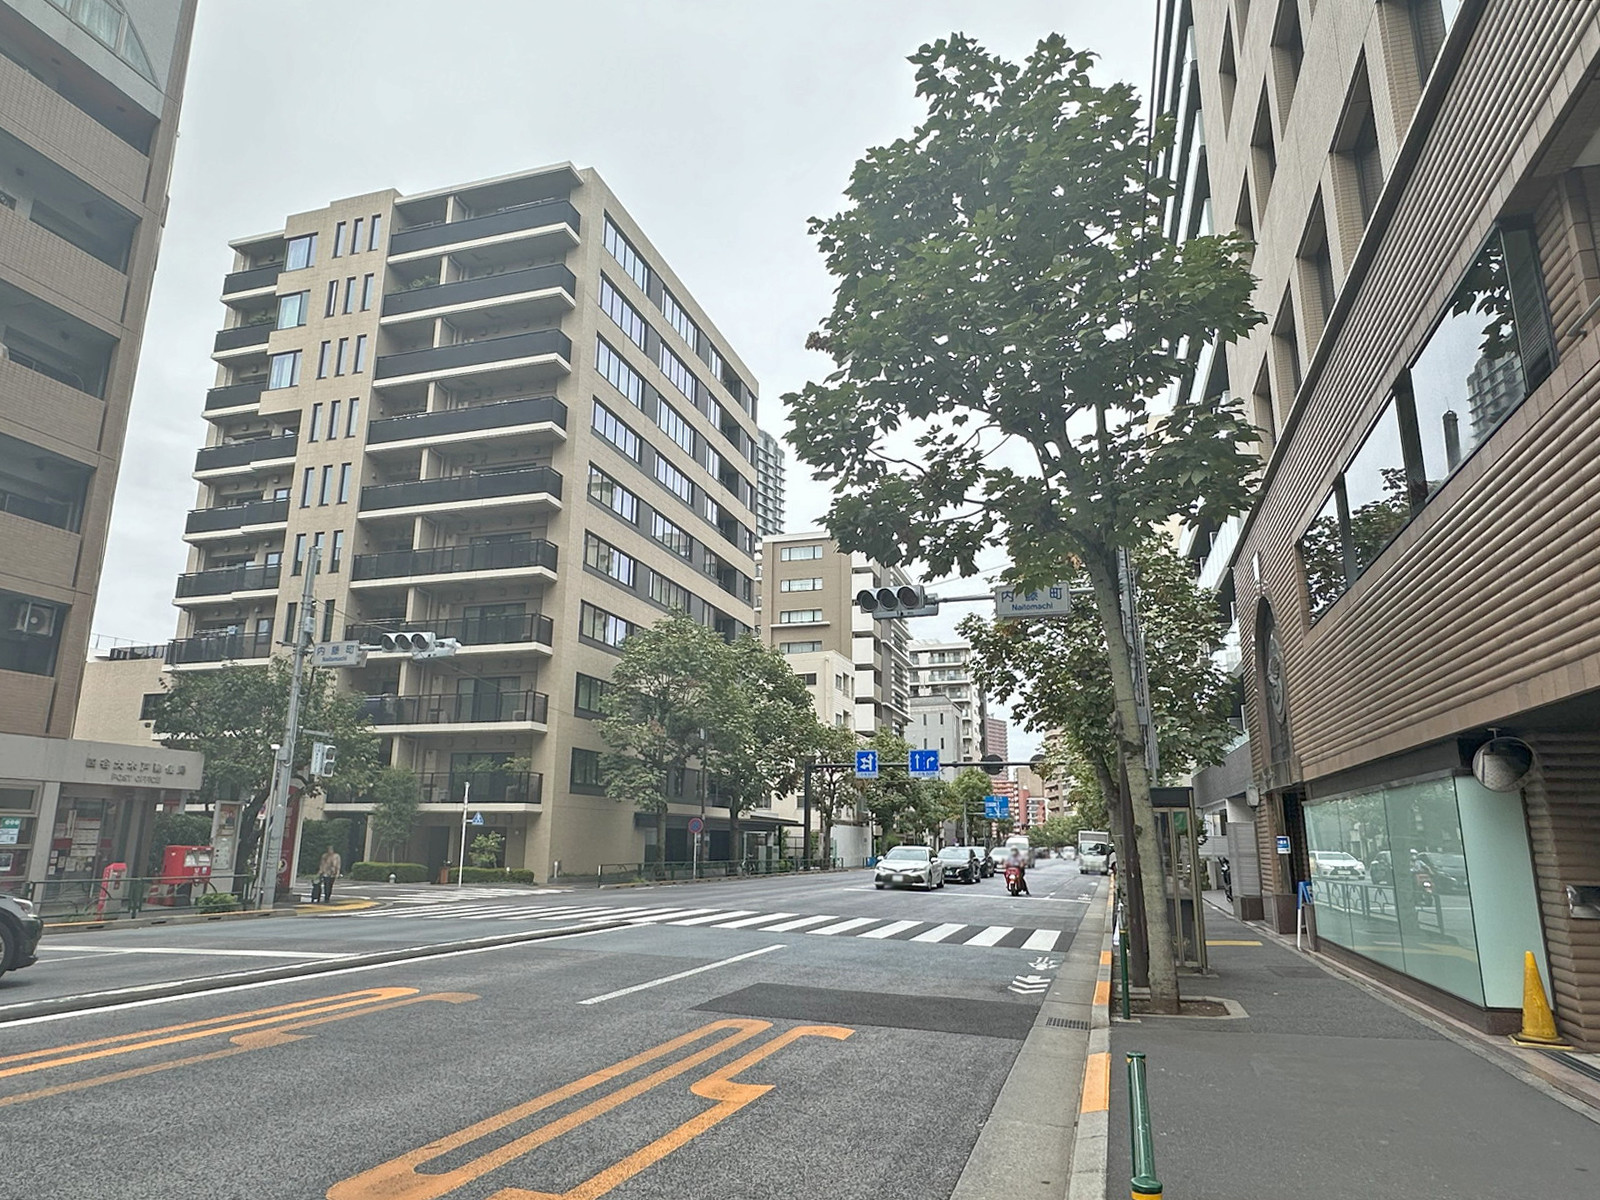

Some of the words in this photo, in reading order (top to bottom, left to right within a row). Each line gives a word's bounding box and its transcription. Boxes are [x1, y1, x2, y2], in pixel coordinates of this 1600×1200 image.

[1011, 602, 1054, 611] Naitomachi
[111, 773, 132, 783] POST
[135, 775, 161, 785] OFFICE
